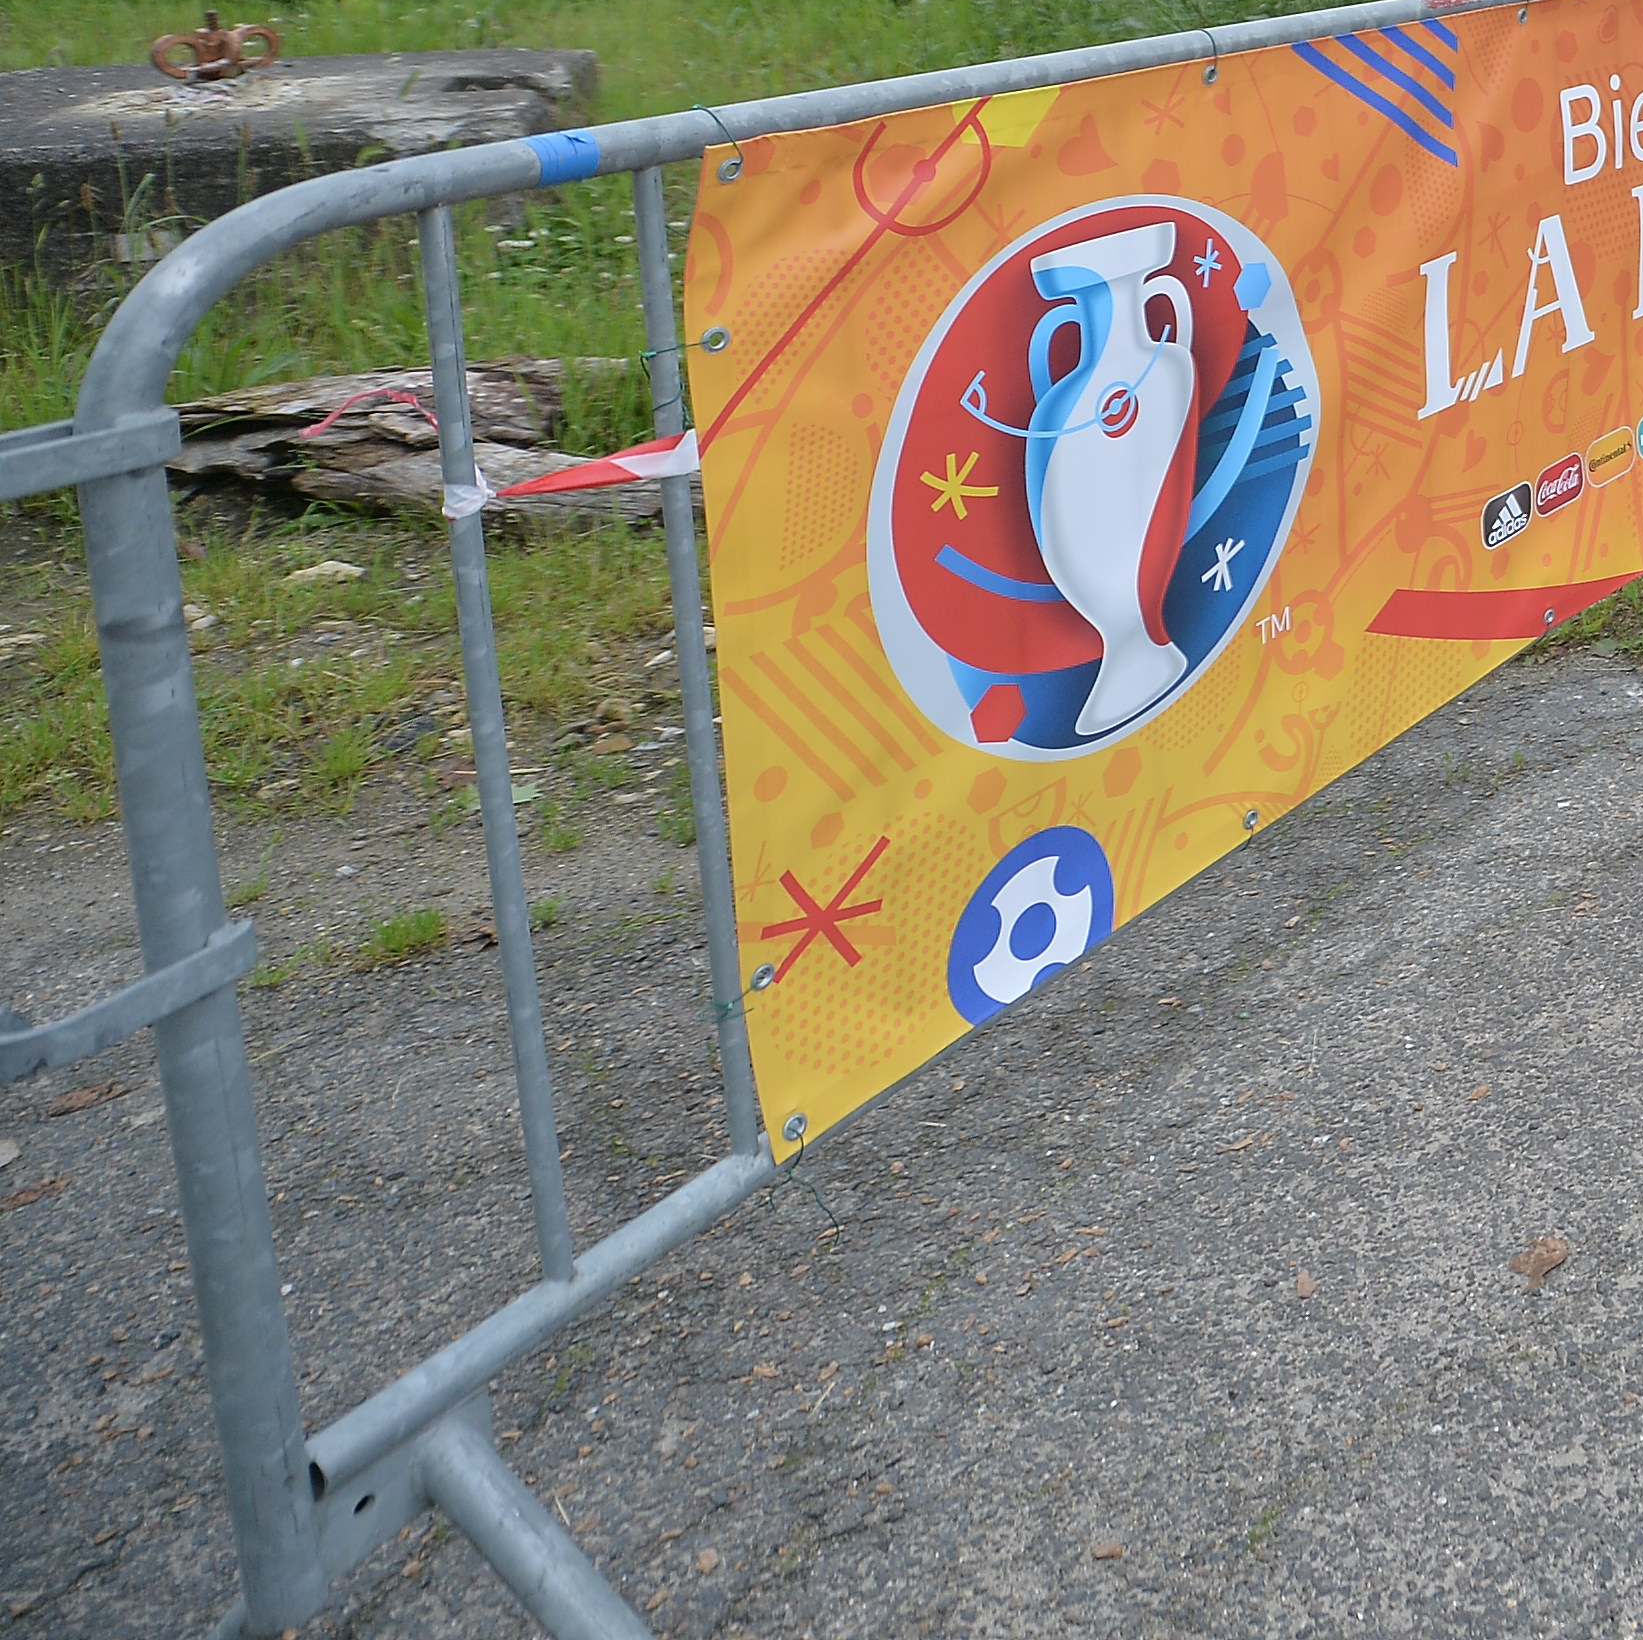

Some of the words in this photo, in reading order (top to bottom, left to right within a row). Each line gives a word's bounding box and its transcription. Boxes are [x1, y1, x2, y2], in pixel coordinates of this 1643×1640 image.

[1417, 213, 1596, 421] LA
[1488, 512, 1528, 545] adidas
[1255, 605, 1291, 645] TM
